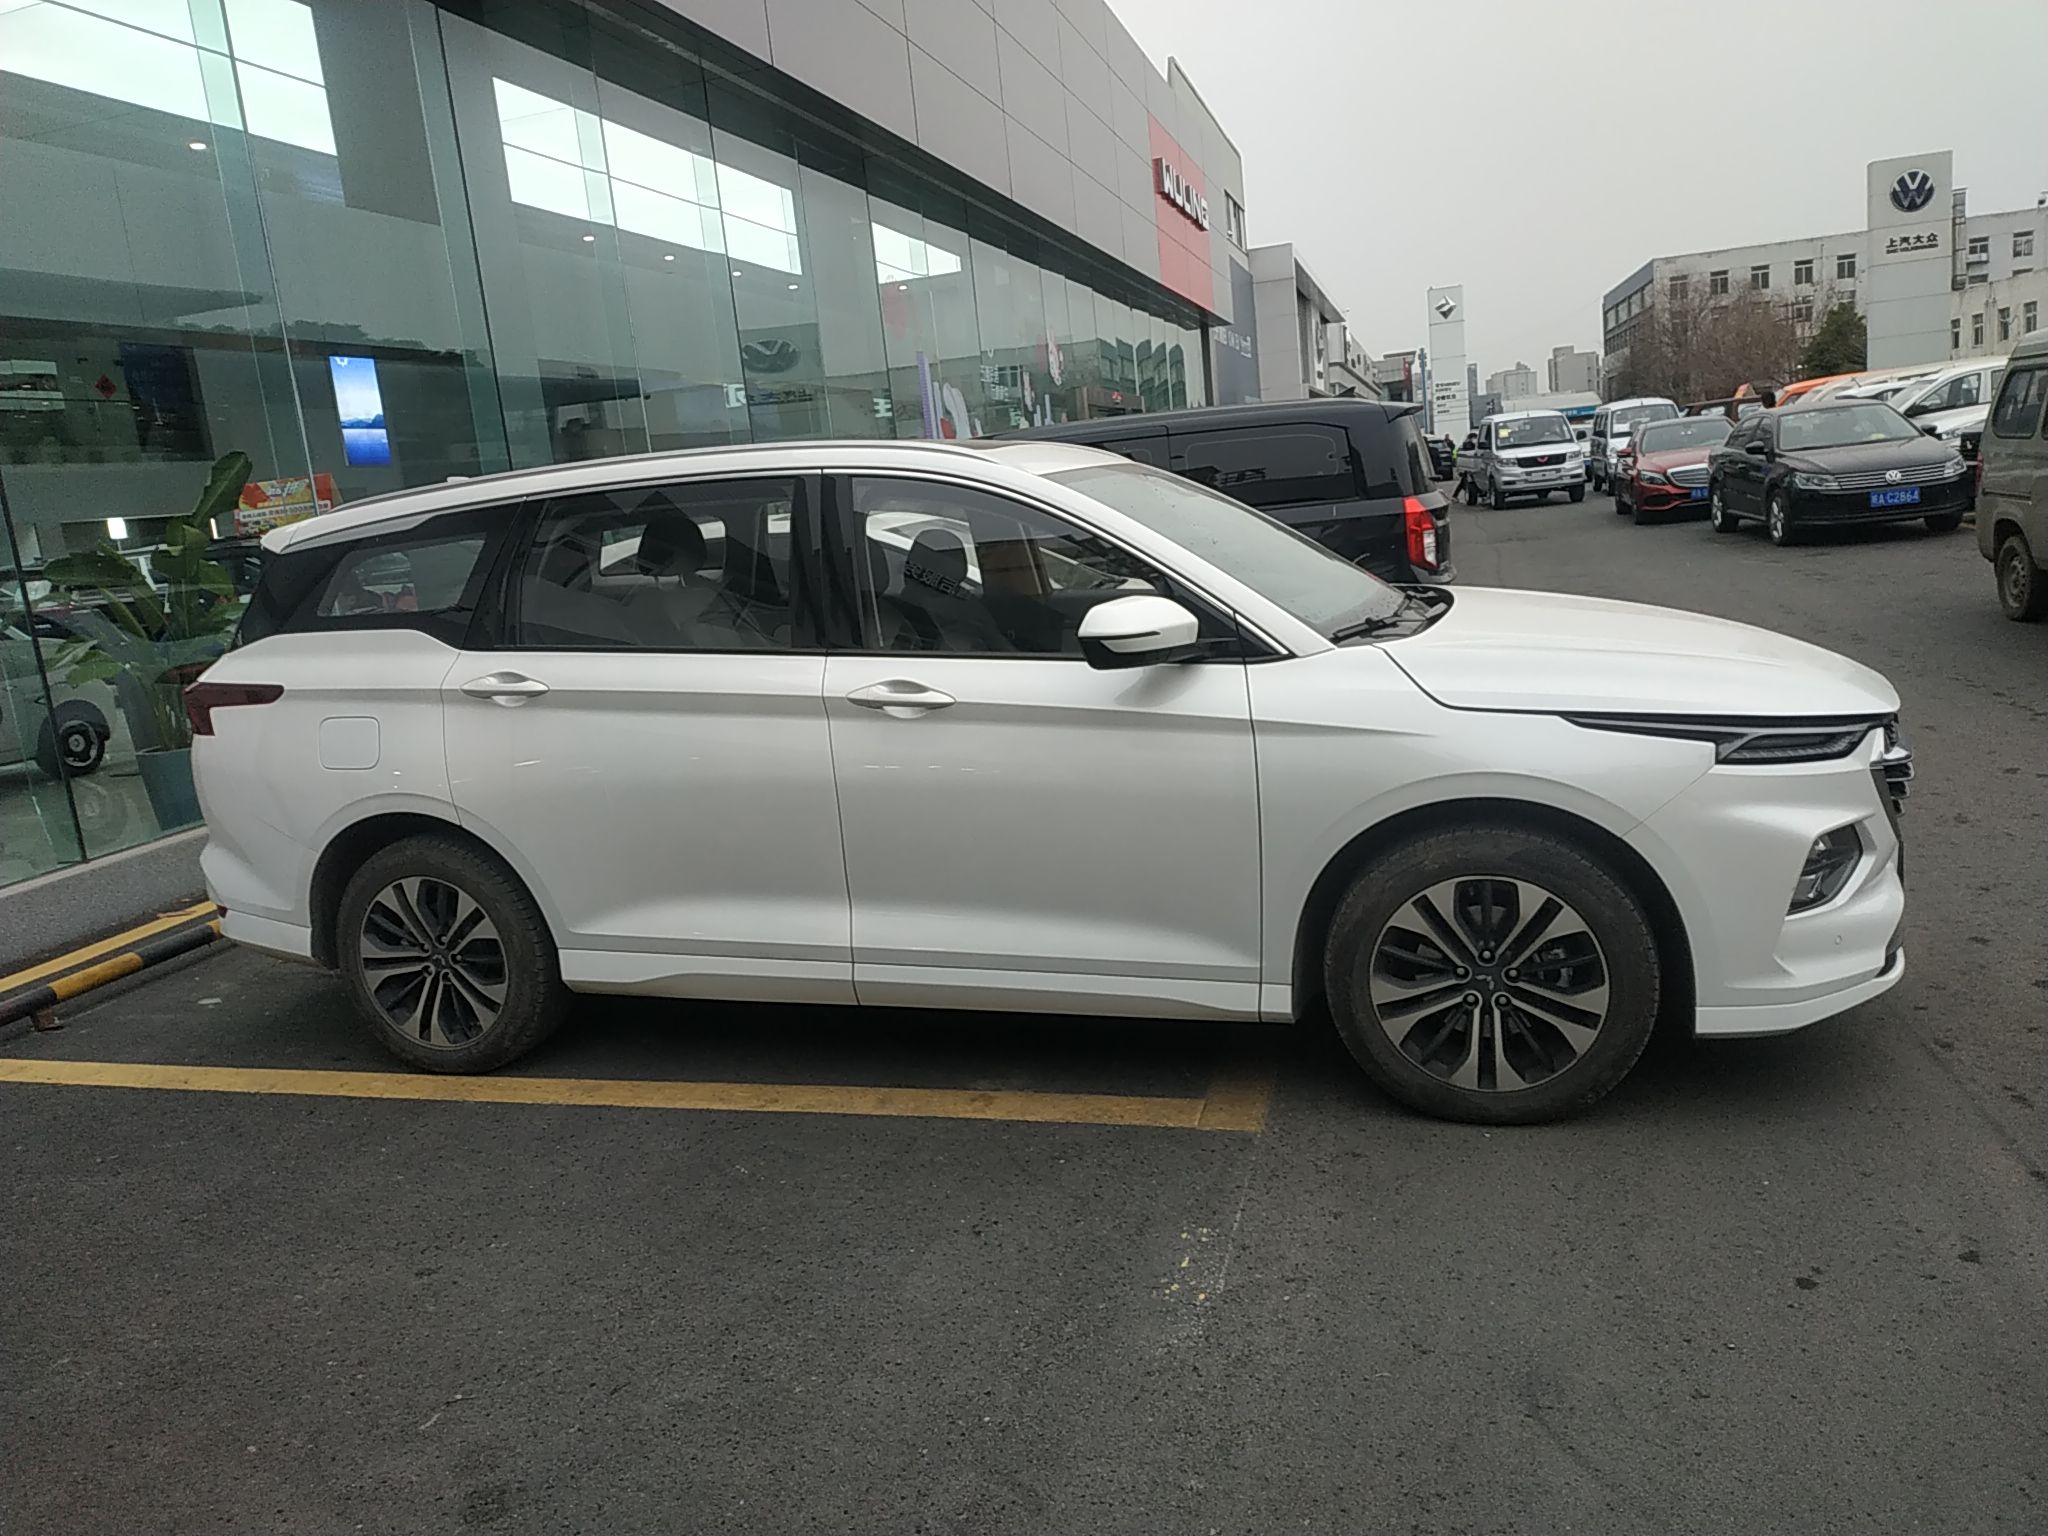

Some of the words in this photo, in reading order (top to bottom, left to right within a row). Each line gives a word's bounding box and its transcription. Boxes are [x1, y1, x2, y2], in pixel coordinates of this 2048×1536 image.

[1161, 158, 1210, 230] WULING
[1886, 232, 1938, 248] 上汽大众
